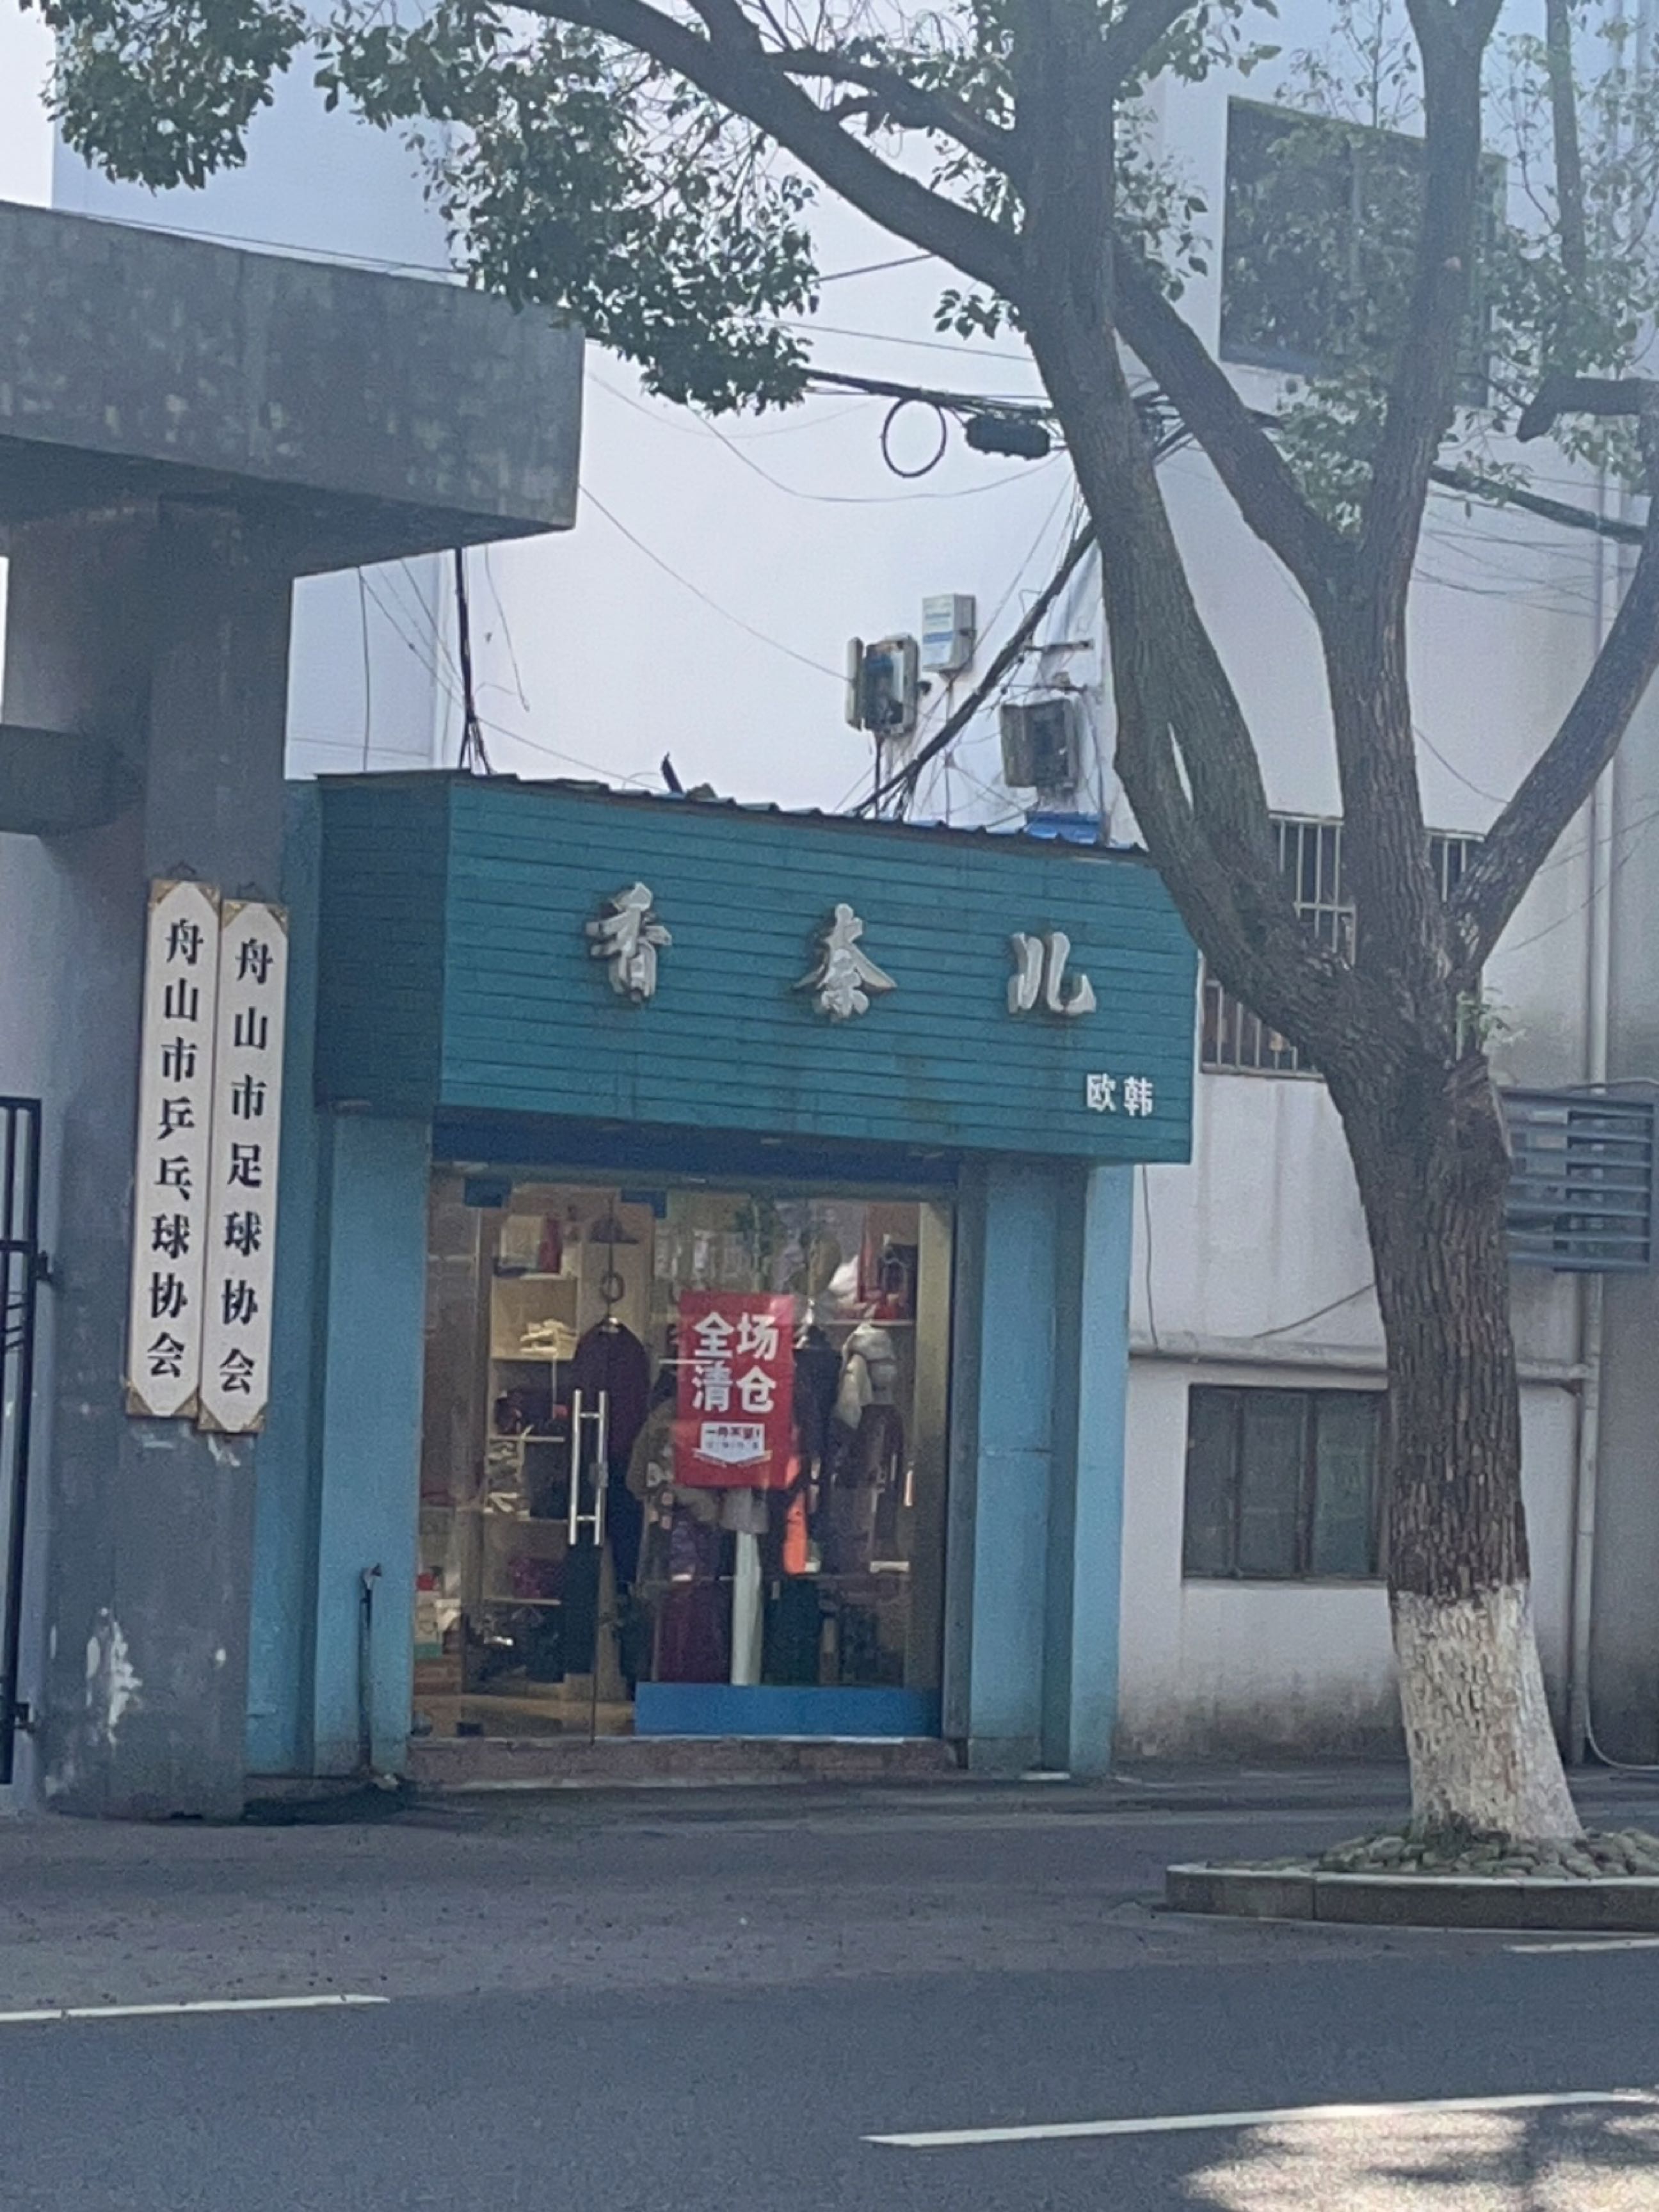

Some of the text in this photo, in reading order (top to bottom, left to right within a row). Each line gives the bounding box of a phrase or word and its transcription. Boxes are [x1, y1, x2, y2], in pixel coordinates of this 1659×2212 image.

[586, 881, 1095, 1022] 香奈儿
[1087, 1073, 1153, 1116] 欧韩
[147, 918, 204, 1377] 舟山市乒乓球协会
[219, 938, 273, 1395] 舟山市足球协会
[693, 1312, 779, 1361] 全场
[691, 1360, 777, 1413] 清仓
